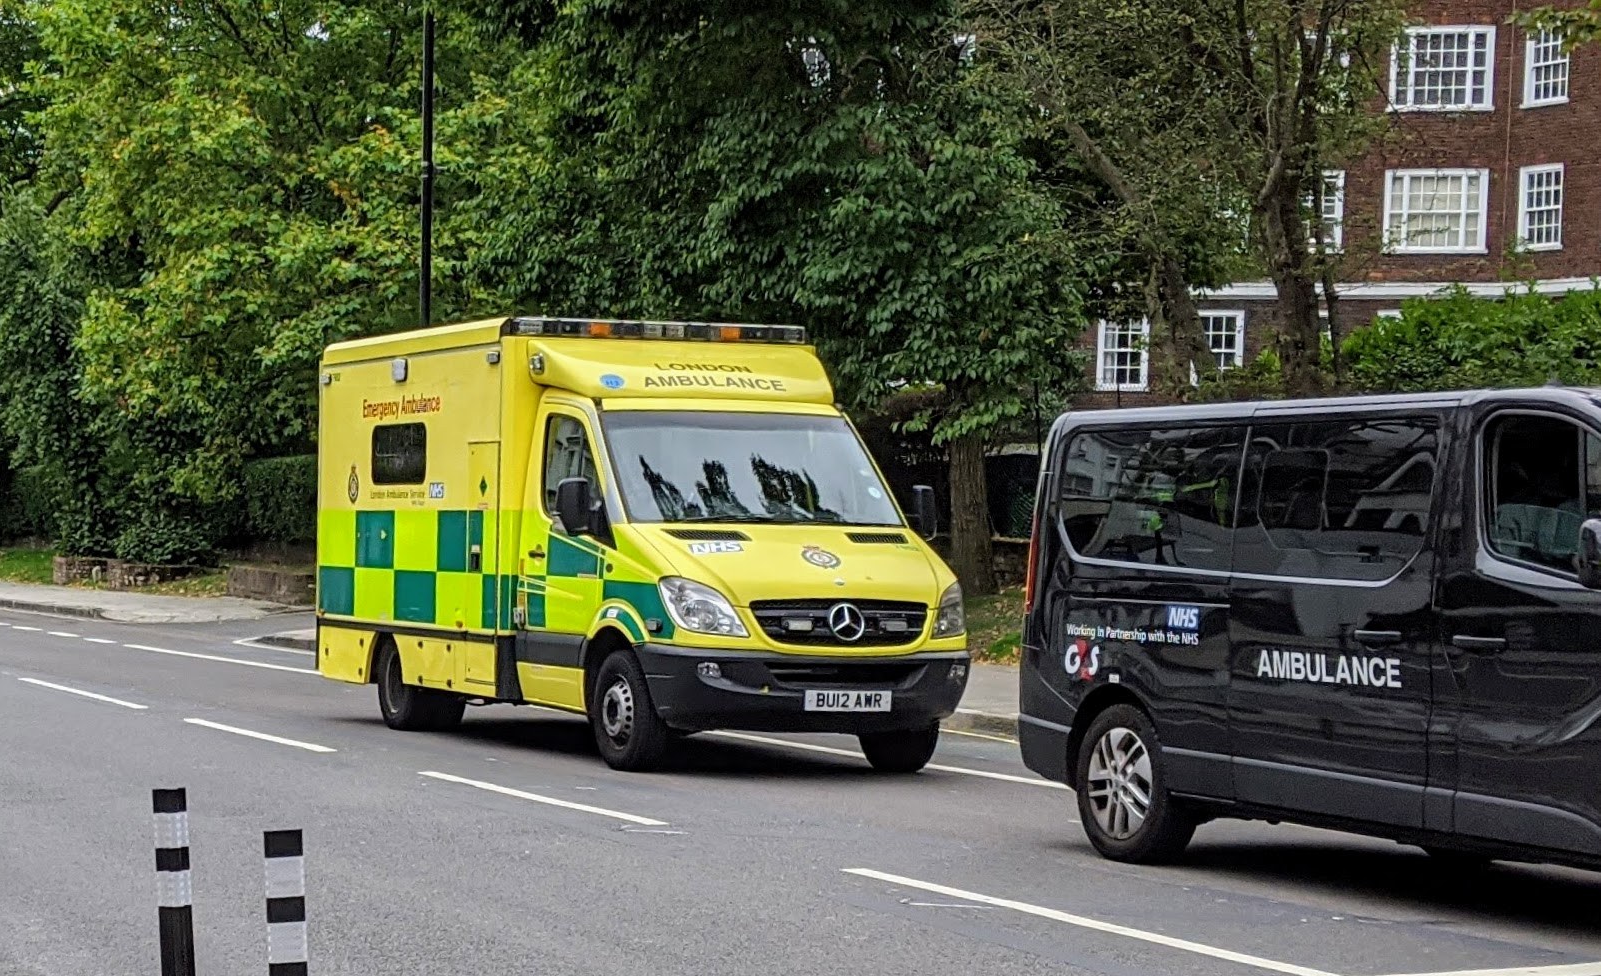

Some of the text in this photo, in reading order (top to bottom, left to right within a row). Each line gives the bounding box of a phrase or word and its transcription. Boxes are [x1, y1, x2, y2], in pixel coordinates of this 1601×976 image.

[654, 362, 752, 373] LONDON
[644, 375, 787, 391] AMBULANCE
[362, 393, 441, 421] Emergency Ambulance
[387, 490, 409, 499] Ambulance
[430, 484, 444, 498] NHS
[691, 542, 742, 554] NHS
[1168, 607, 1199, 628] NHS
[1066, 623, 1096, 640] Working
[1105, 626, 1147, 643] Partnership
[1148, 630, 1165, 642] with
[1167, 631, 1180, 644] the
[1182, 633, 1199, 645] NHS
[1257, 649, 1402, 688] AMBULANCE
[816, 693, 882, 708] BU12 AWR
